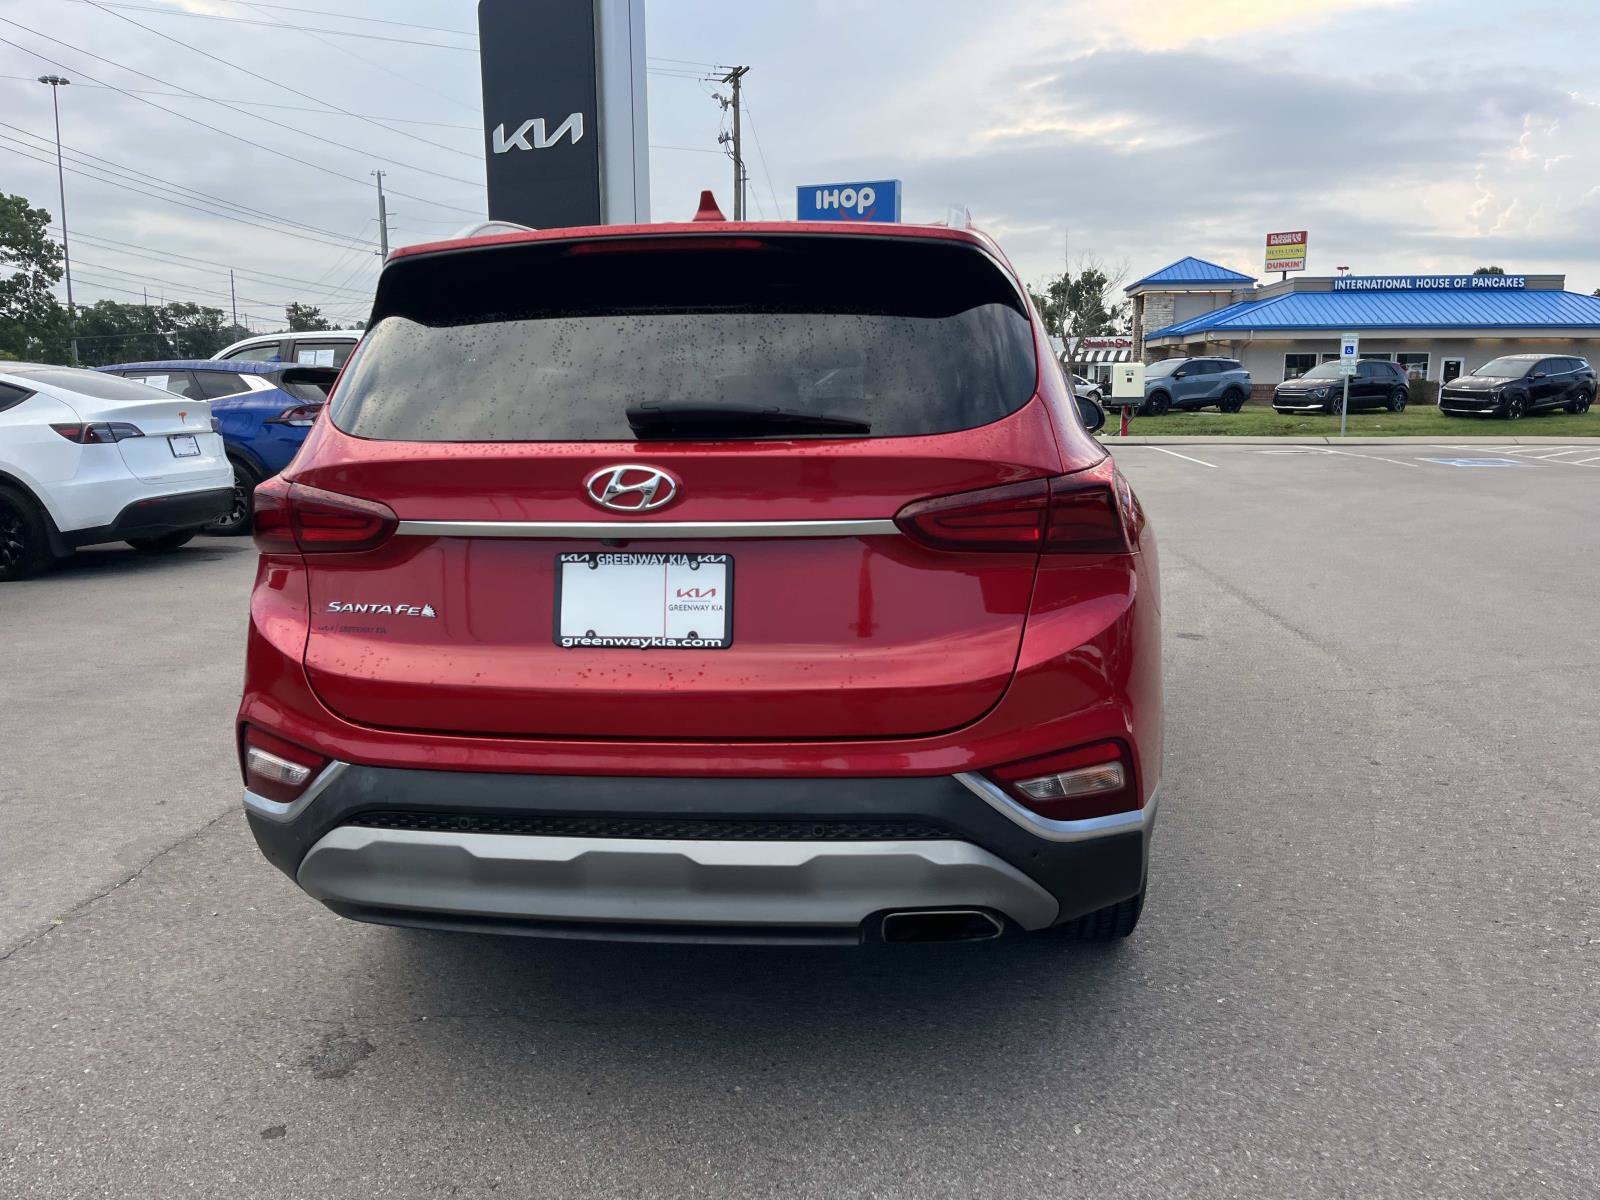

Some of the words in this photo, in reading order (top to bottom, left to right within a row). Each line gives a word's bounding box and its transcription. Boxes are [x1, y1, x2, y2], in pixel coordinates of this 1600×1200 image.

[493, 112, 583, 153] KIA
[815, 187, 876, 214] IHOP
[1266, 260, 1303, 269] DUNKIN'
[1334, 279, 1412, 290] INTERNATIONAL
[1416, 278, 1450, 288] HOUSE
[1454, 278, 1467, 288] OF
[1472, 277, 1525, 288] PANCAKES
[561, 553, 590, 562] KIA
[596, 553, 666, 566] GREENWAY
[668, 554, 690, 566] KIA
[697, 554, 727, 563] KIA
[676, 587, 717, 598] KIA
[327, 601, 393, 614] SANTA
[668, 604, 709, 612] GREENWAY
[711, 604, 724, 612] KIA
[561, 636, 722, 648] greenwaykia.com
